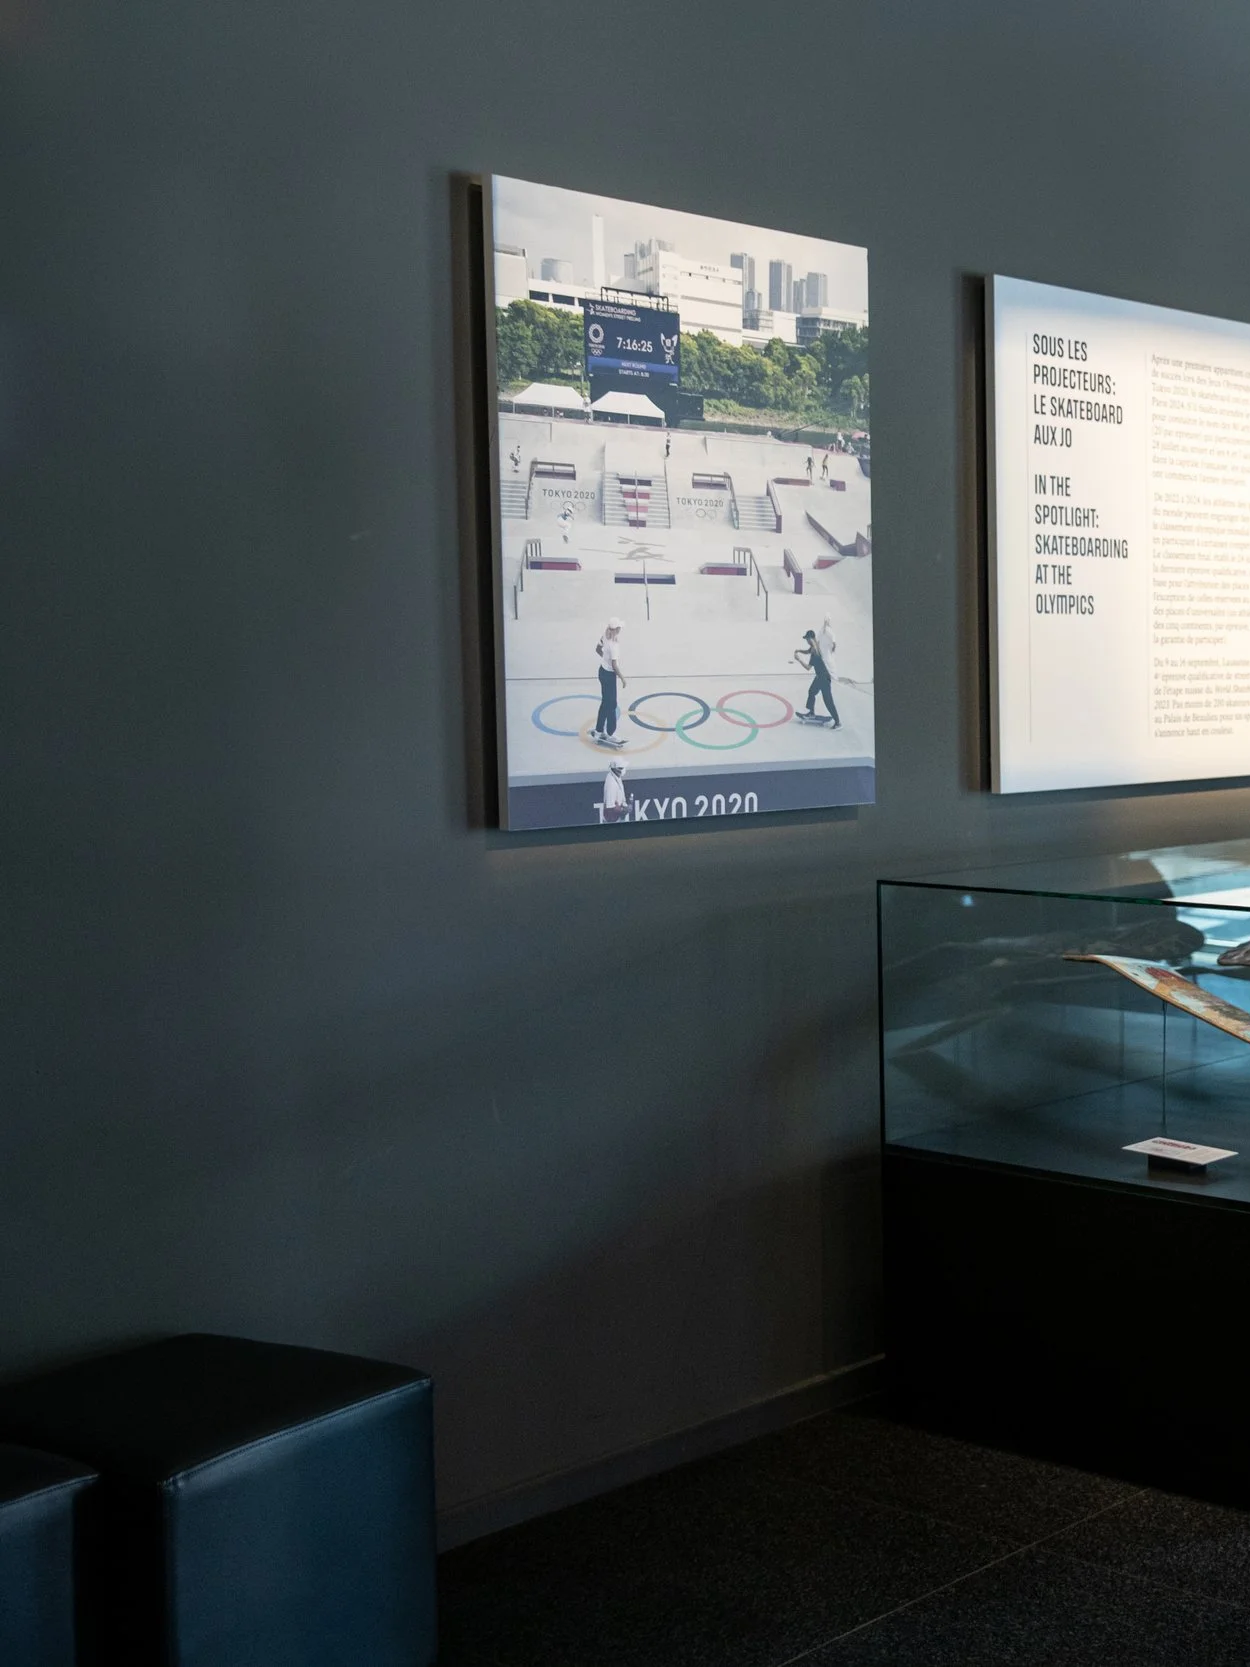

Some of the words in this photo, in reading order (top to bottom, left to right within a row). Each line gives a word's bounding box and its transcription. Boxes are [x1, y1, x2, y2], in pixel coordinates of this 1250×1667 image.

[616, 337, 653, 353] 7:16:25
[1033, 333, 1064, 357] SOUS
[1067, 340, 1088, 361] LES
[1033, 364, 1116, 396] PROJECTEURS:
[1033, 394, 1047, 415] LE
[1050, 397, 1123, 425] SKATEBOARD
[1033, 424, 1057, 446] AUX
[1060, 427, 1072, 448] JO
[542, 488, 572, 498] TOKYO
[573, 489, 596, 499] 2020
[1034, 474, 1046, 495] IN
[1050, 475, 1071, 497] THE
[676, 497, 702, 506] TOKYO
[704, 498, 724, 507] 2020
[1034, 504, 1099, 529] SPOTLIGHT:
[1035, 534, 1128, 559] SKATEBOARDING
[1035, 563, 1049, 585] AT
[1051, 564, 1072, 585] THE
[1036, 593, 1095, 615] OLYMPICS
[694, 791, 759, 817] 2020
